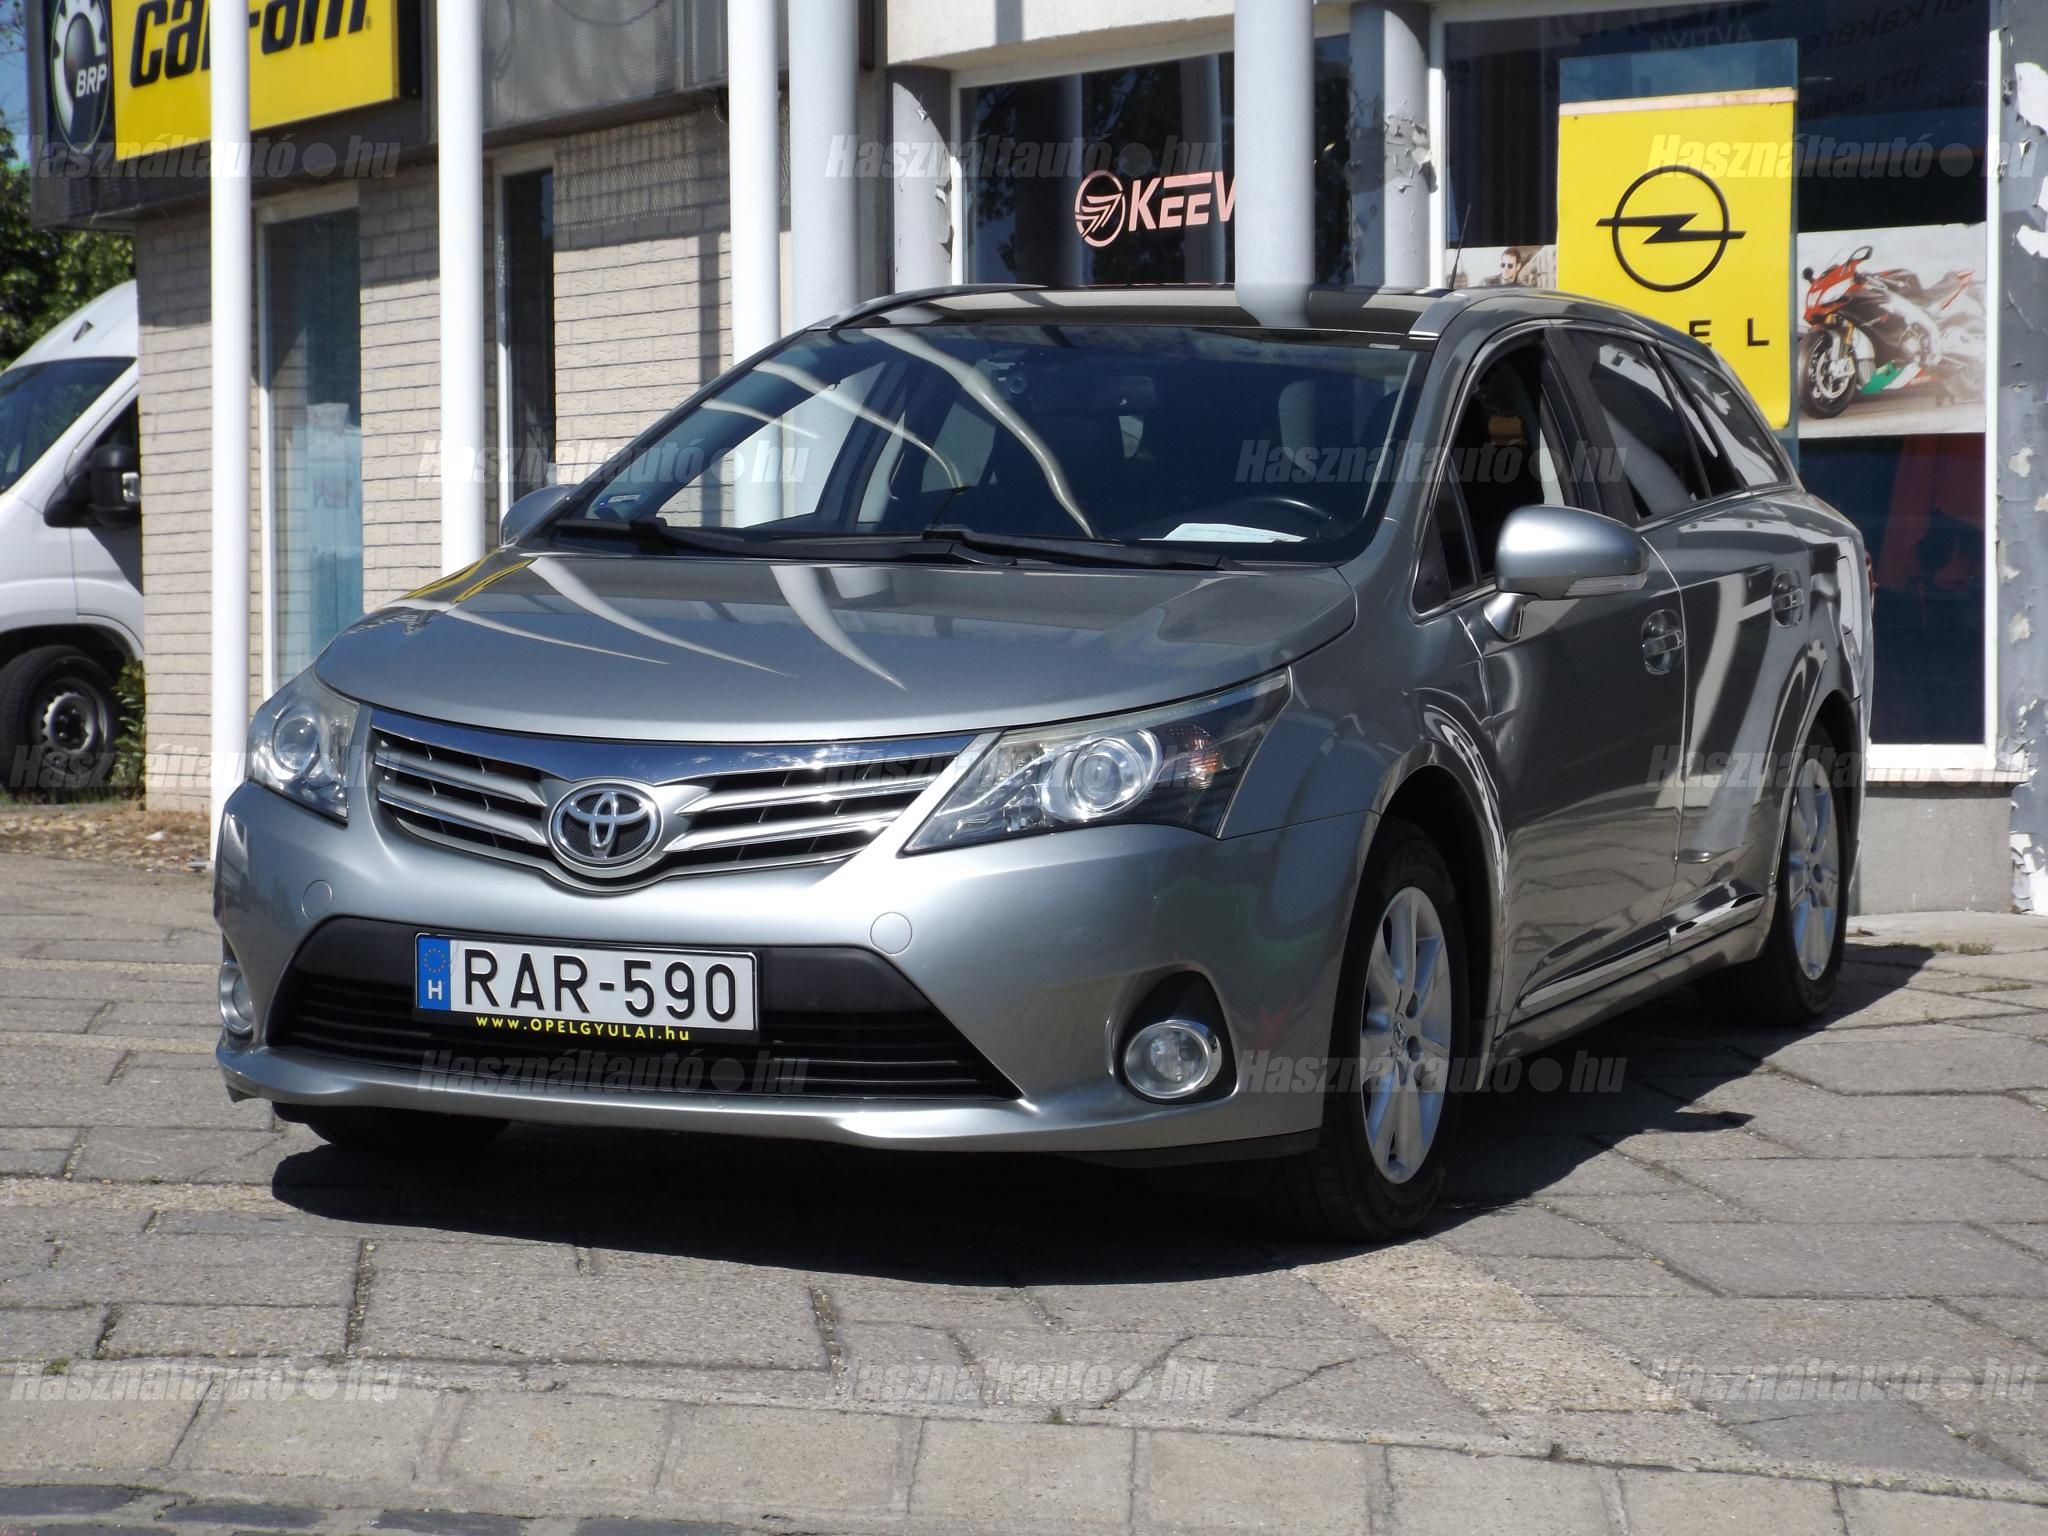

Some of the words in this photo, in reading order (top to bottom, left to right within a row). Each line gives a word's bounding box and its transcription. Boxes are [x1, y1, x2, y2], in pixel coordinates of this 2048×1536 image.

[76, 61, 108, 98] BRP
[427, 980, 442, 1001] H
[463, 947, 737, 1022] RAR-590
[475, 1016, 690, 1042] www.OPELGYULAI.hu
